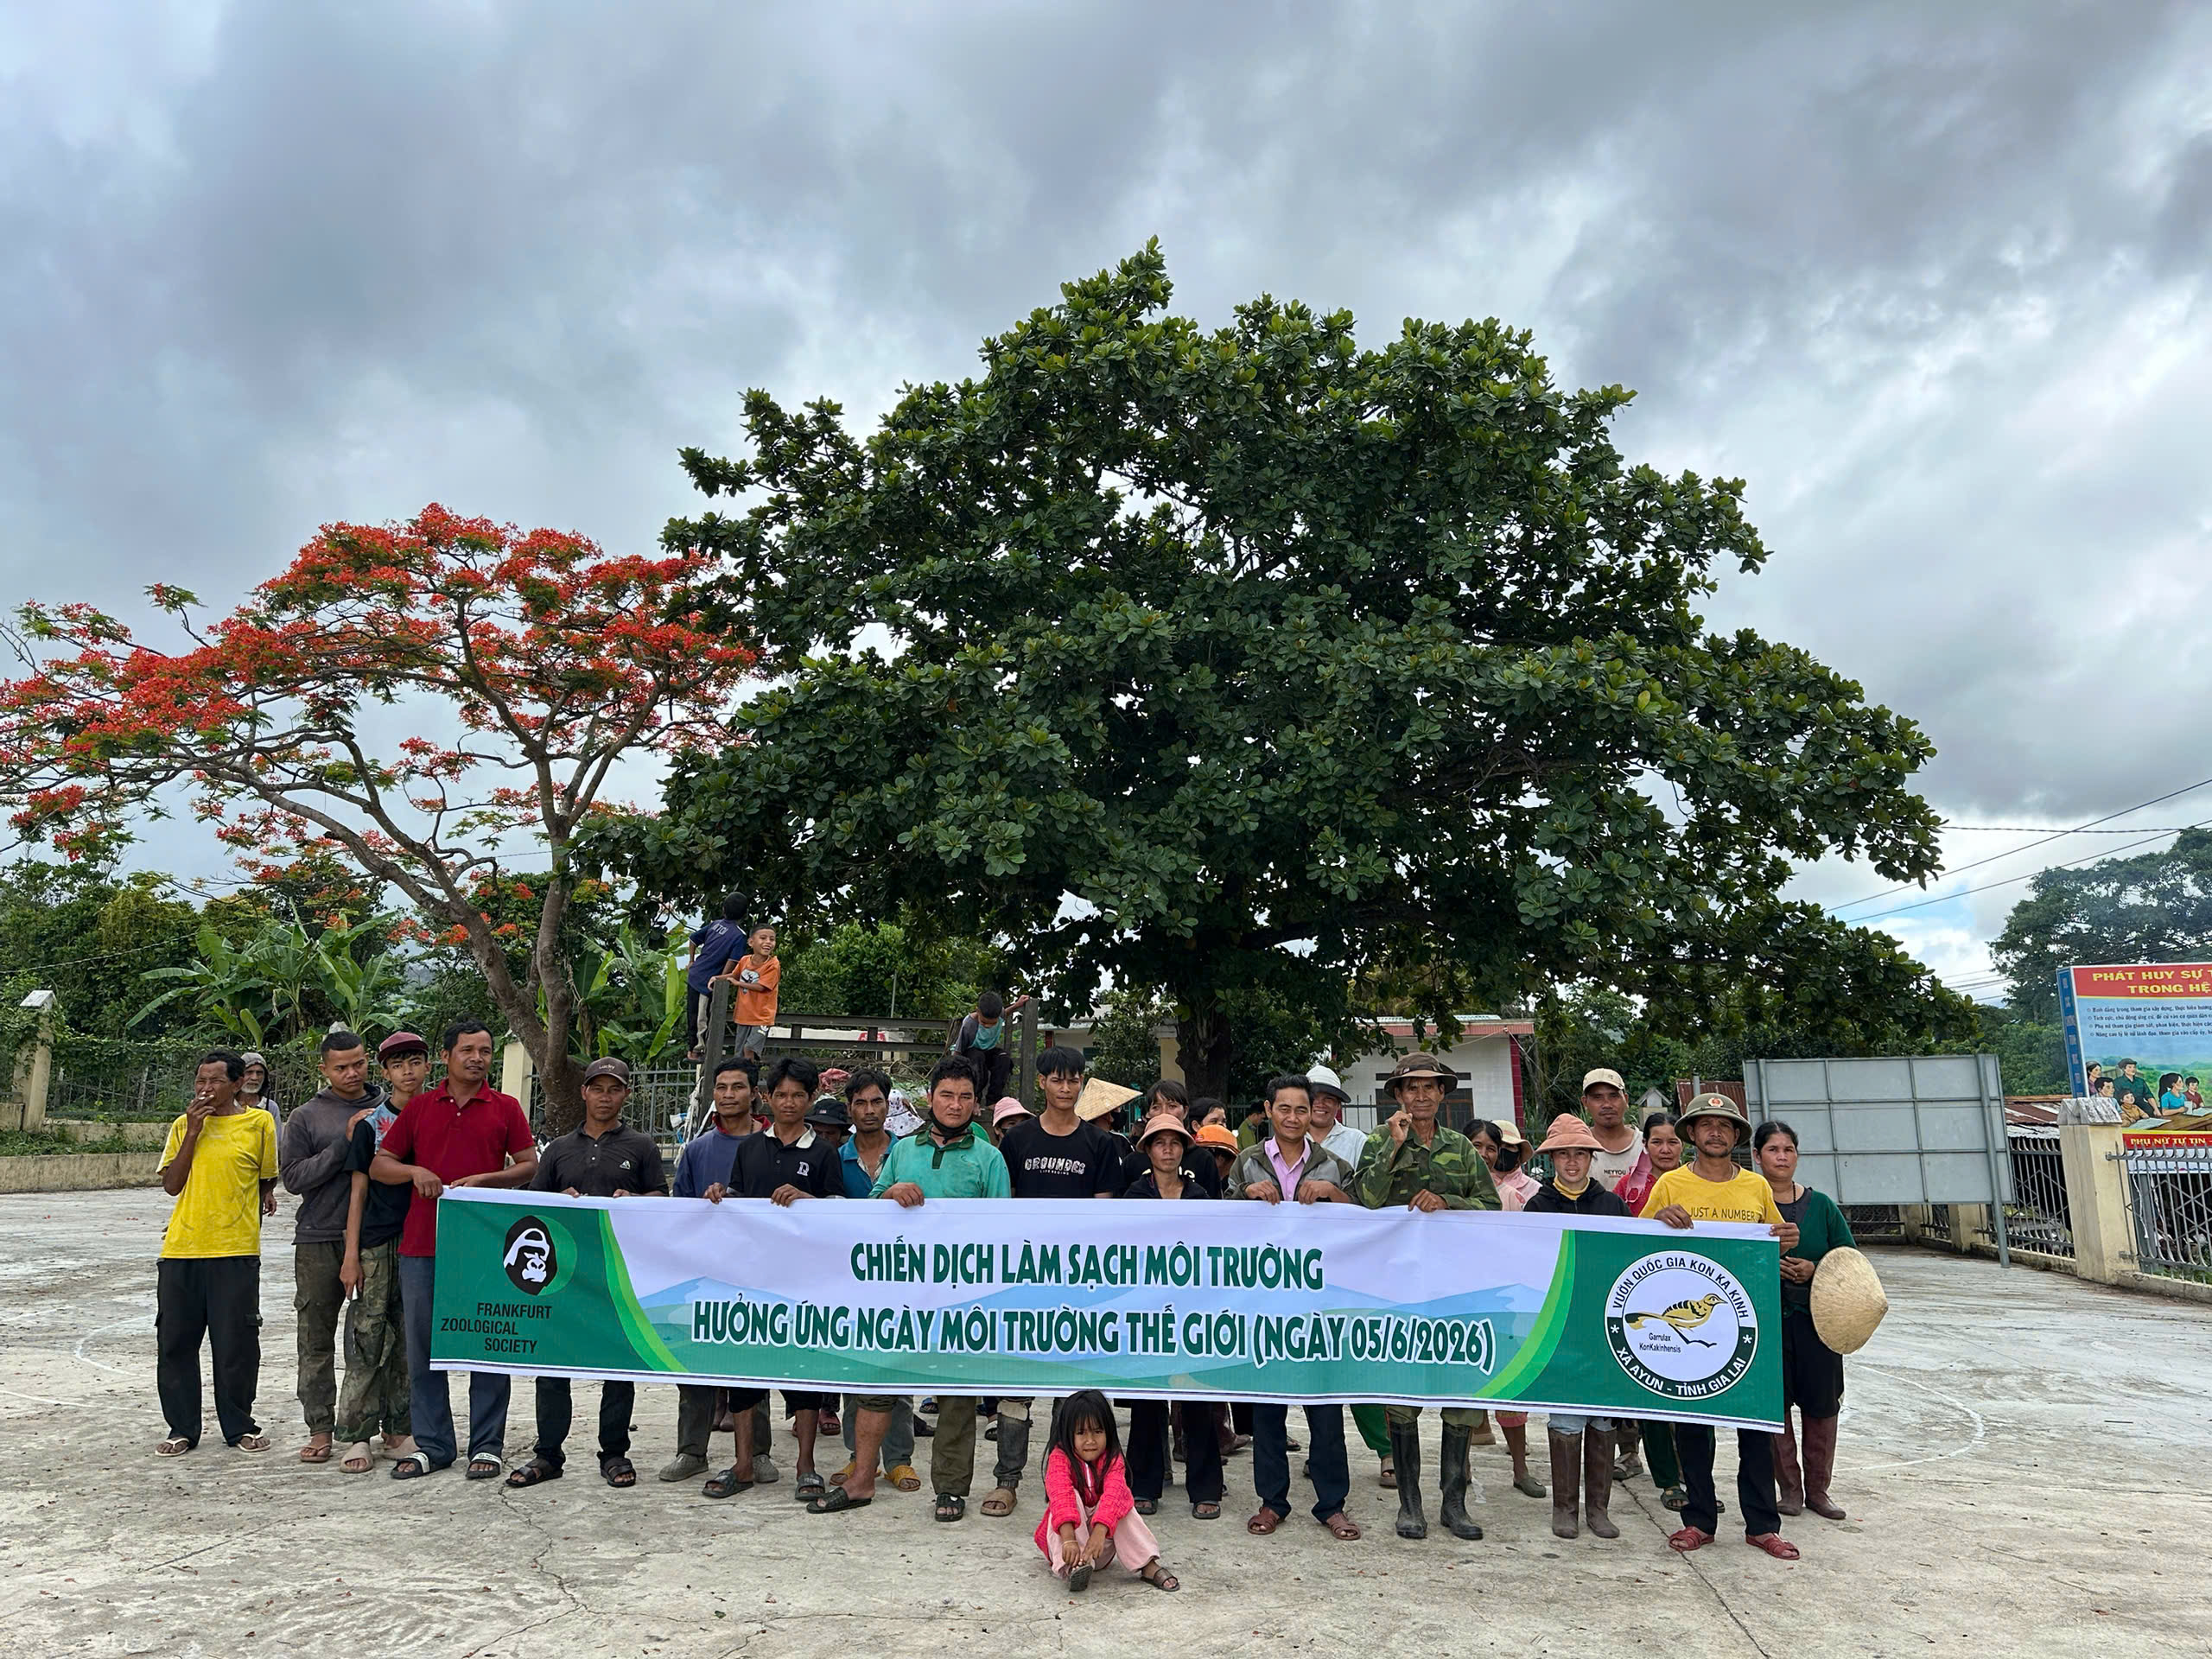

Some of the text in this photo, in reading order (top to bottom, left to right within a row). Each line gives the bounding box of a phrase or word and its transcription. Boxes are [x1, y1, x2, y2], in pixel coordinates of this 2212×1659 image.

[2092, 970, 2135, 982] PHÁT
[2141, 970, 2175, 980] HUY
[2180, 969, 2203, 980] SỰ
[2127, 982, 2212, 994] TRONG HỆ
[2130, 1138, 2151, 1147] PHỤ
[2153, 1136, 2171, 1145] NỮ
[1690, 1207, 1755, 1221] JUST A NUMBER
[850, 1235, 1324, 1290] CHIẾN DỊCH LÀM SẠCH MÔI TRƯỜNG
[1612, 1257, 1749, 1319] VƯỜN QUỐC GIA KON KA KINH
[477, 1302, 552, 1319] FRANKFURT
[441, 1319, 518, 1335] ZOOLOGICAL
[694, 1293, 1491, 1372] HƯỞNG ỨNG NGÀY MÔI TRƯỜNG THẾ GIỚI (NGÀY 05/6/2026)
[484, 1338, 537, 1354] SOCIETY
[1617, 1346, 1633, 1366] XÃ
[1630, 1364, 1663, 1391] AYUN
[1675, 1382, 1707, 1396] TỈNH
[1708, 1374, 1732, 1392] GIA
[1728, 1357, 1746, 1377] LAI
